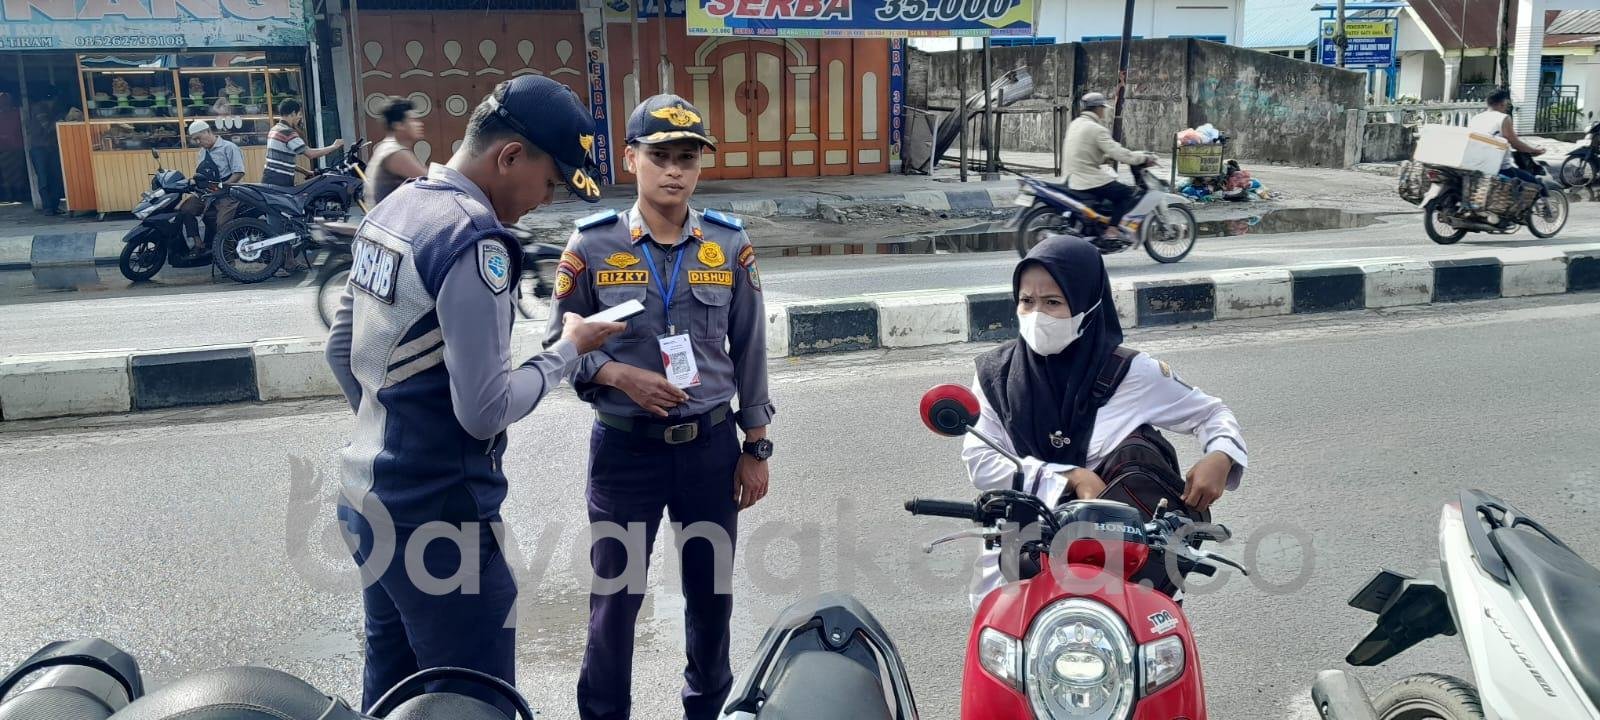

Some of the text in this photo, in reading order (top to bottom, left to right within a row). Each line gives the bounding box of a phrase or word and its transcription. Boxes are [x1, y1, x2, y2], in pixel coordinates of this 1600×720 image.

[705, 0, 853, 20] SERBA
[875, 0, 1012, 22] 35.000
[7, 36, 53, 48] TIRAM
[590, 50, 605, 120] SERBA
[600, 272, 644, 282] RIZKY
[691, 272, 730, 283] DISHUB
[1092, 522, 1143, 536] HONDA
